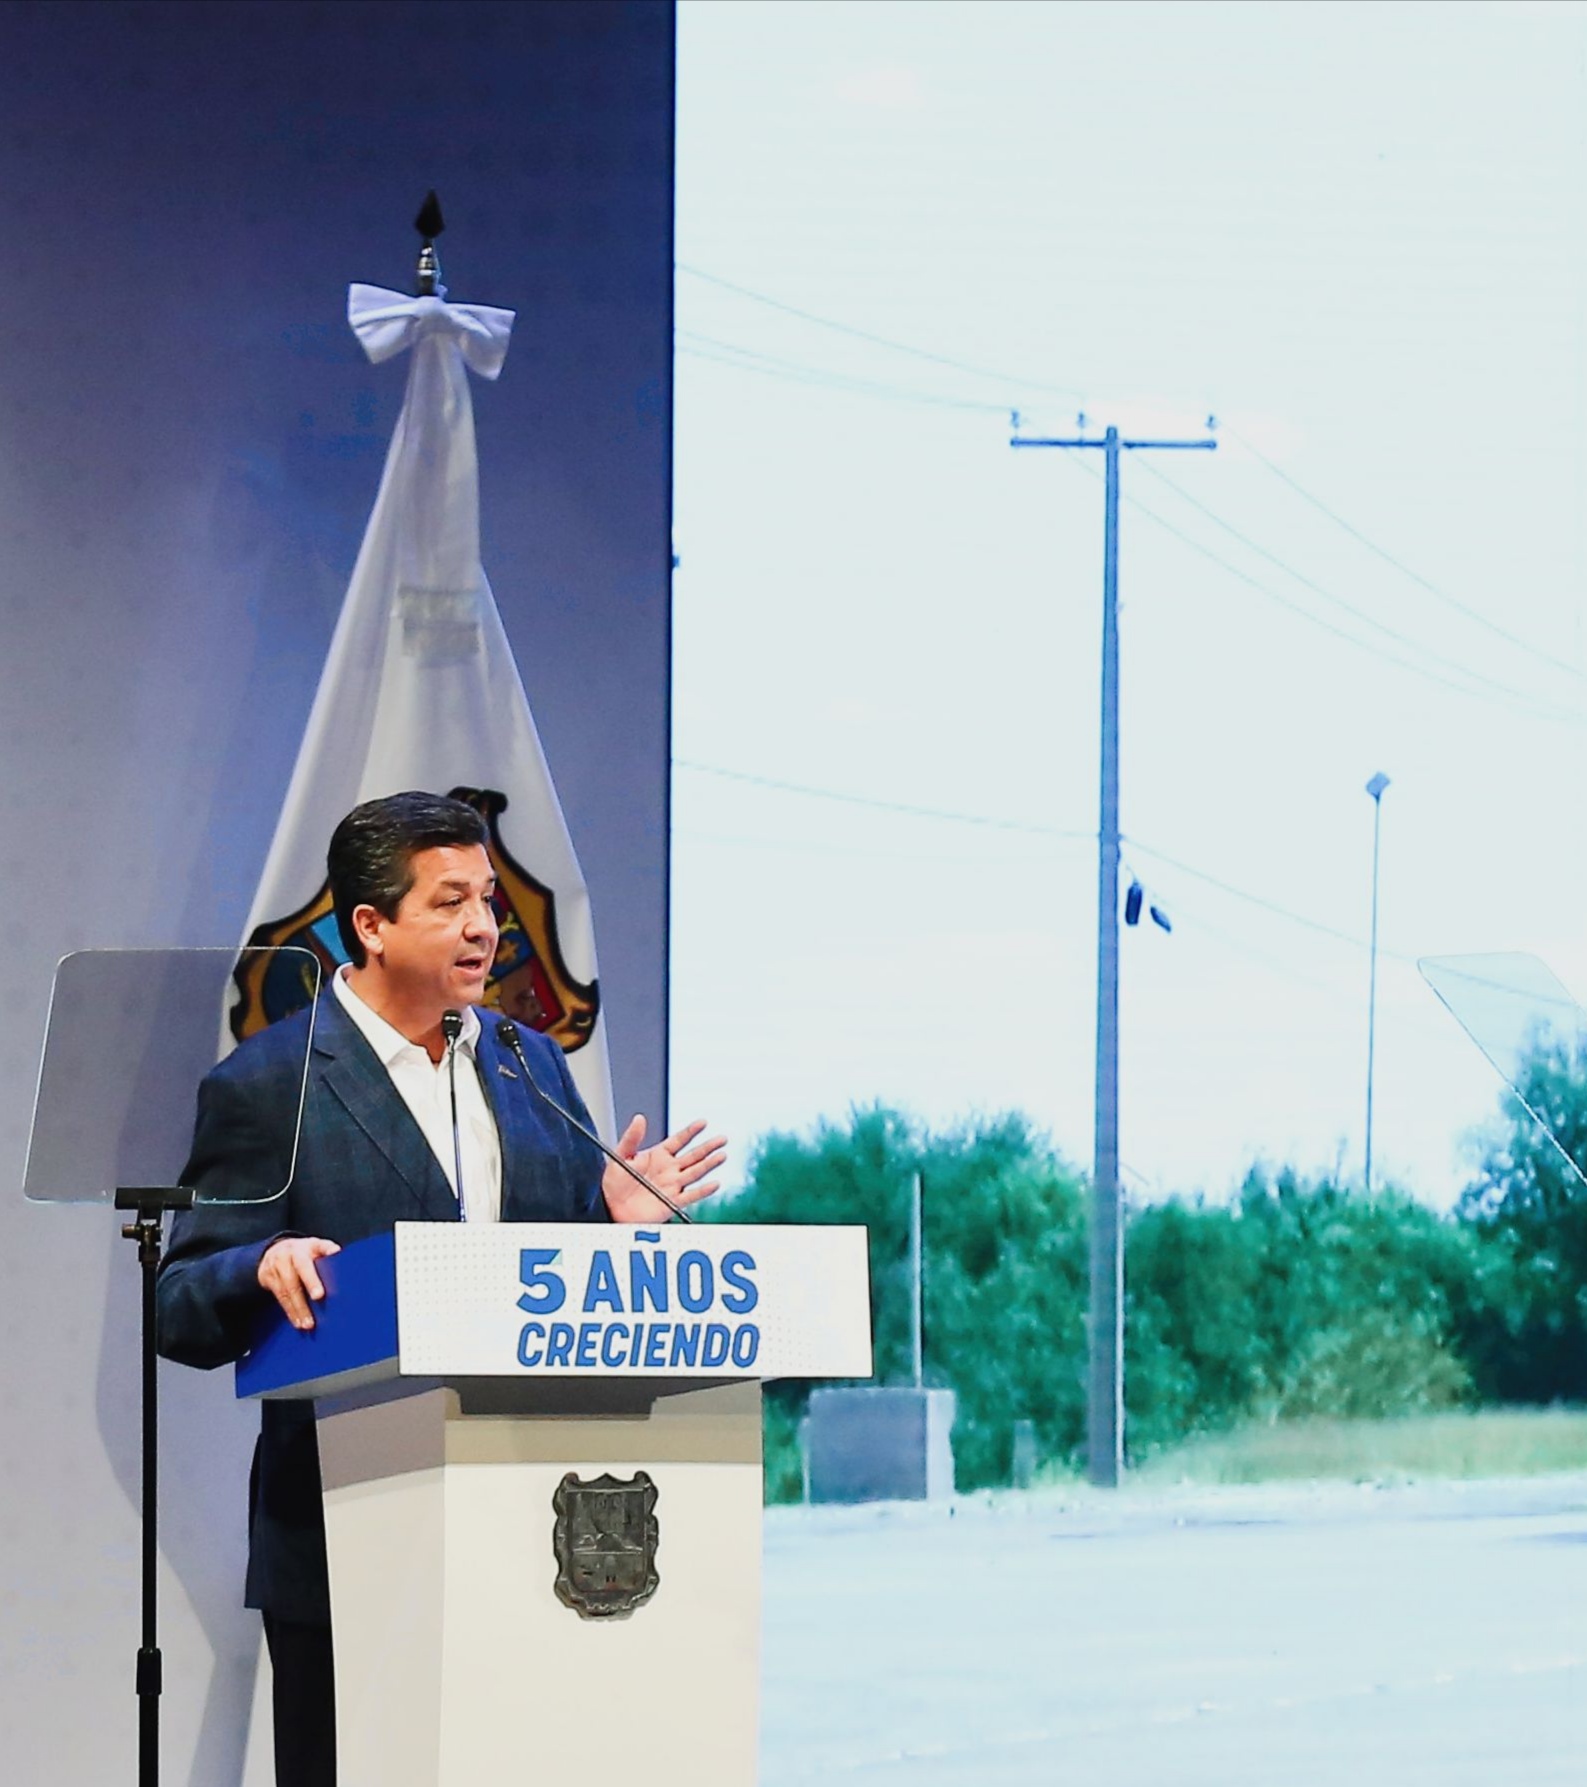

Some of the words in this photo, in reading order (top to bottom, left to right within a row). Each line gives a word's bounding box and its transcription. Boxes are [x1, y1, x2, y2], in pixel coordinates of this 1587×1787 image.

[516, 1249, 567, 1315] 5
[582, 1230, 759, 1314] AÑOS
[516, 1322, 761, 1368] CRECIENDO
